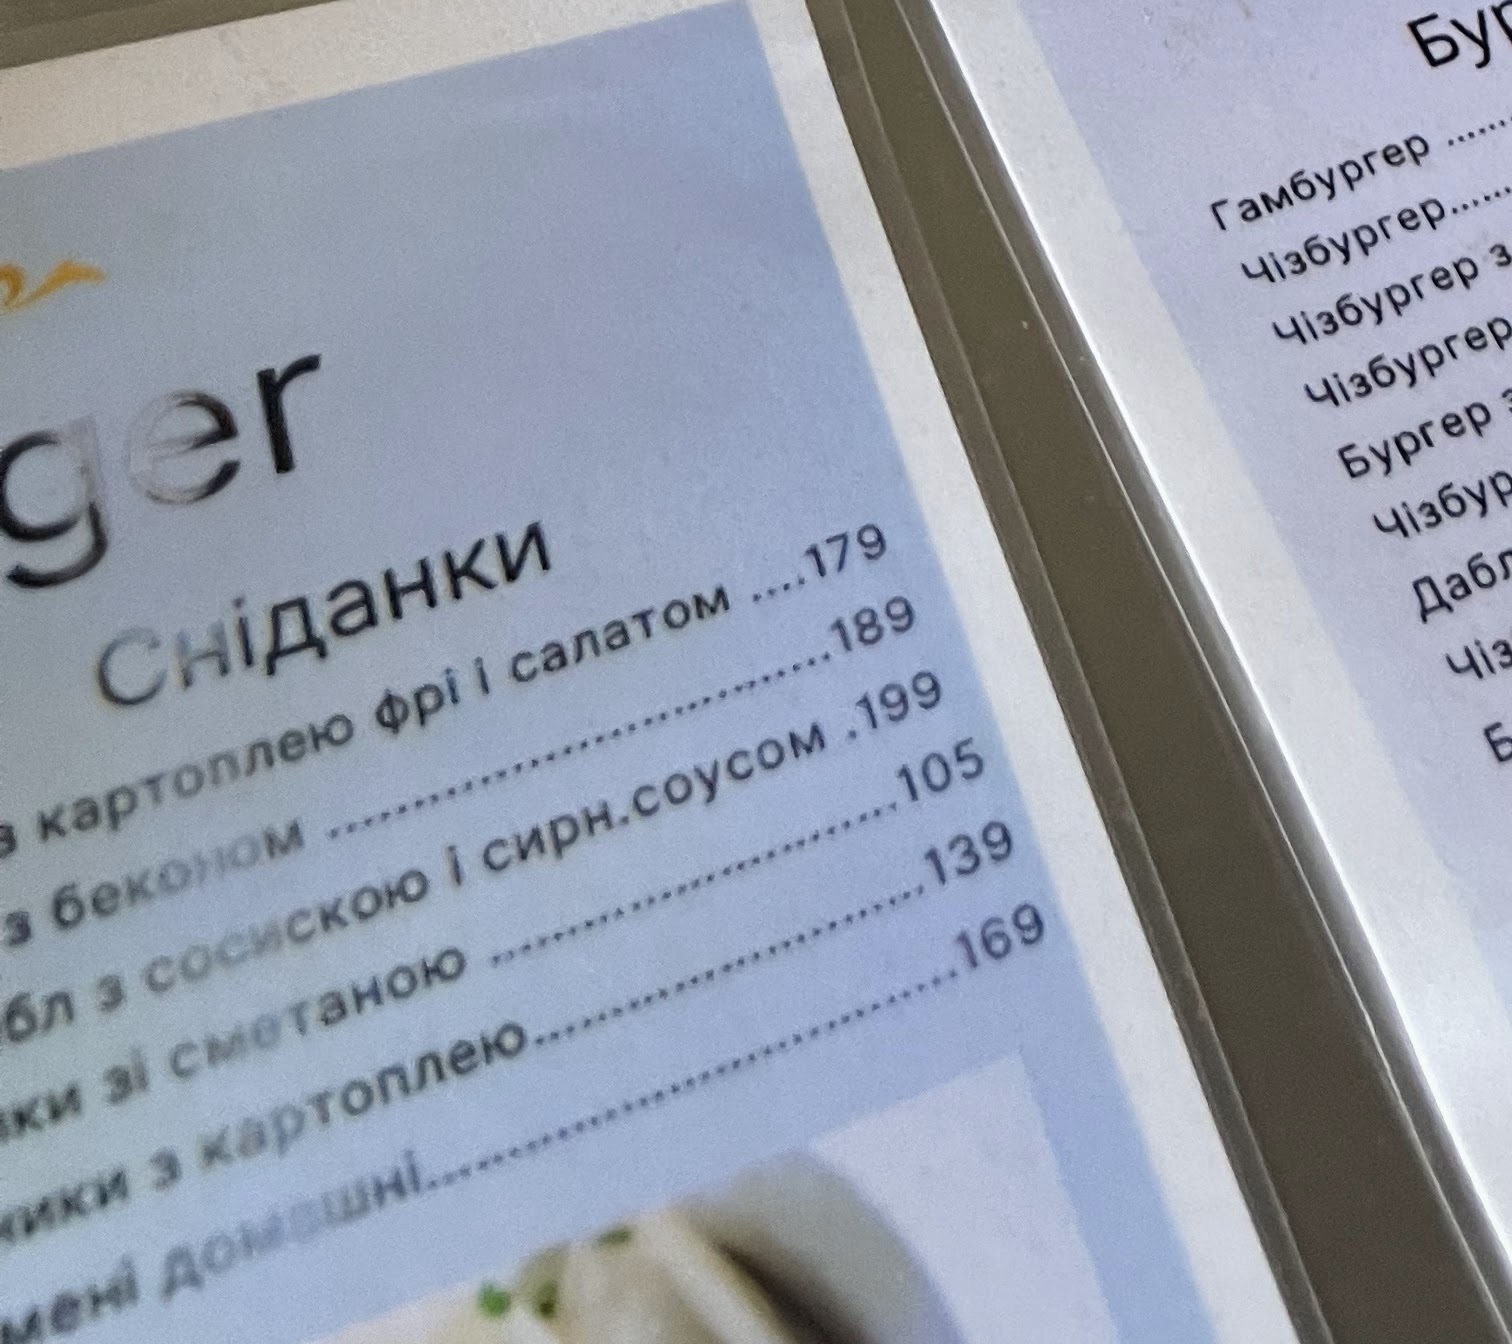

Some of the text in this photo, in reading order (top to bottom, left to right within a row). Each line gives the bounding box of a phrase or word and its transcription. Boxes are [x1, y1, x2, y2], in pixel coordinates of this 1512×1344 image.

[1211, 134, 1430, 230] Гамбургер
[1241, 196, 1448, 284] Чізбургер
[1273, 253, 1479, 345] Чізбургер
[1491, 243, 1512, 268] з
[1305, 314, 1512, 408] Чізбургер
[1337, 401, 1492, 480] Бургер
[37, 714, 354, 843] картоплею
[375, 667, 459, 733] фрі
[511, 586, 729, 682] салатом
[805, 524, 887, 578] 179
[96, 521, 549, 707] Сніданки
[52, 821, 304, 931] беконом
[831, 595, 916, 654] 189
[99, 973, 125, 1013] з
[143, 869, 429, 994] сосискою
[483, 722, 826, 872] сирн.соусом
[855, 670, 943, 731] 199
[169, 946, 466, 1081] сметаною
[897, 737, 984, 801] 105
[149, 1146, 182, 1192] з
[200, 1022, 528, 1169] картоплею
[923, 820, 1013, 885] 139
[953, 903, 1044, 970] 169
